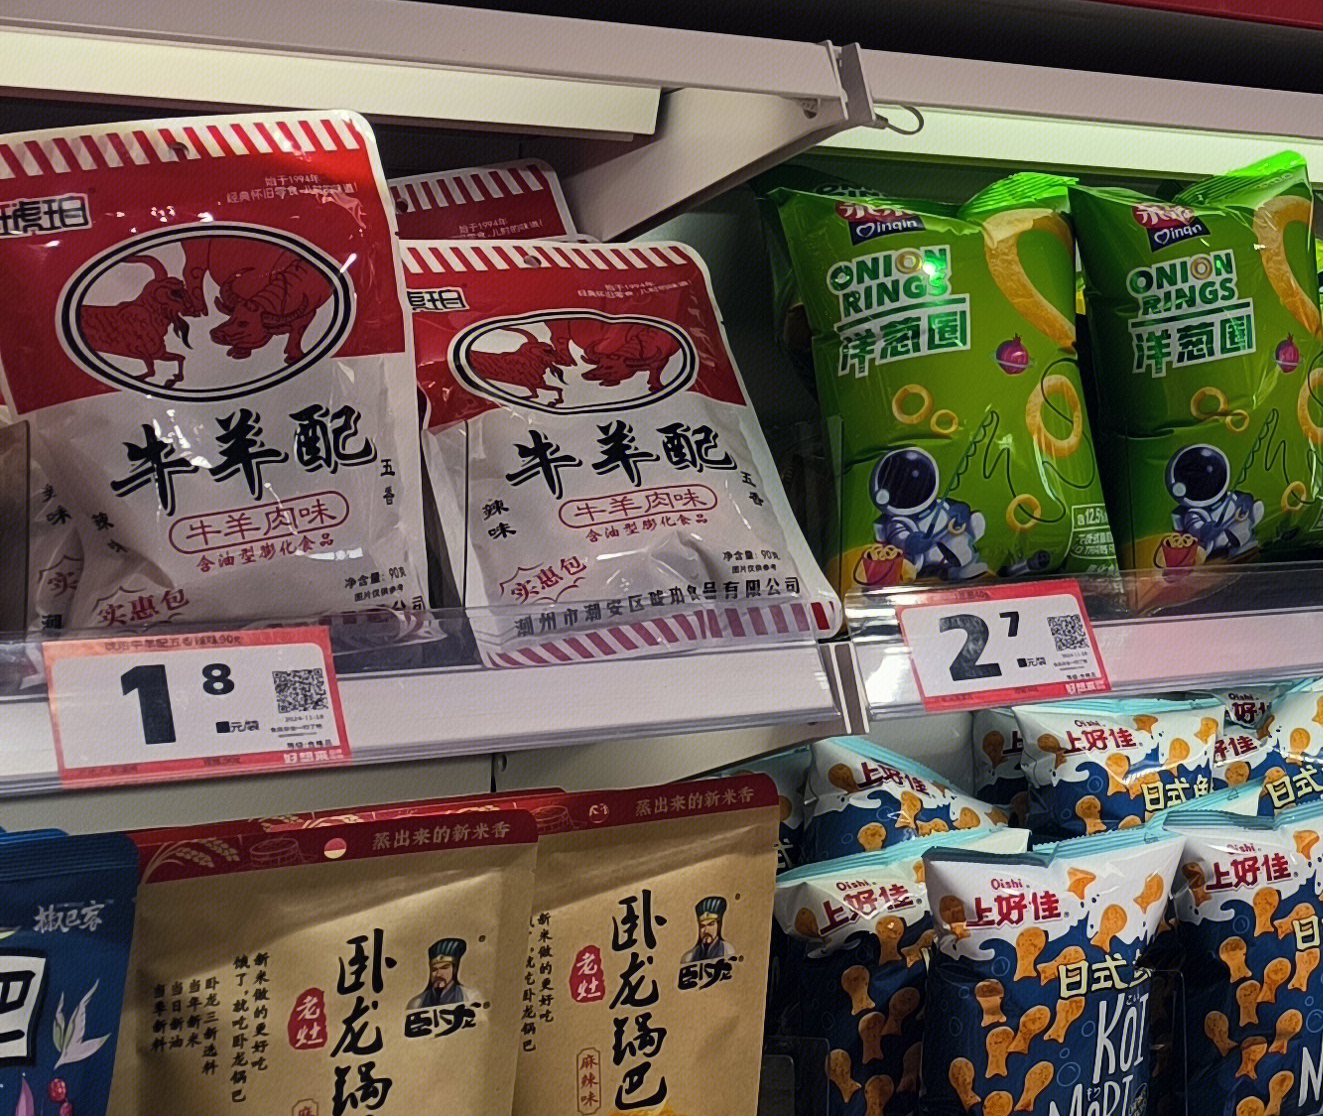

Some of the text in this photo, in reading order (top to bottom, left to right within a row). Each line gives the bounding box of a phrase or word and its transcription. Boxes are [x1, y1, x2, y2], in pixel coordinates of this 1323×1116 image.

[828, 247, 949, 291] ONION
[1128, 252, 1234, 291] ONION
[841, 275, 950, 318] RINGS
[1140, 281, 1236, 316] RINGS
[838, 311, 970, 375] 洋葱圈
[1132, 314, 1254, 376] 洋葱圈
[111, 404, 377, 516] 牛羊配
[506, 420, 737, 500] 牛羊配
[186, 499, 337, 545] 牛羊肉味
[482, 498, 517, 540] 辣味
[575, 488, 708, 522] 牛羊肉味
[586, 514, 708, 542] 含油型膨化食品
[197, 532, 334, 572] 含油型膨化食品
[510, 554, 586, 602] 实惠包
[98, 588, 190, 627] 实惠包
[940, 611, 1019, 681] 2 7
[121, 662, 235, 745] 1 8
[1064, 728, 1139, 754] 上好佳
[858, 761, 930, 796] 上好佳
[636, 785, 755, 817] 蒸出来的新米香
[373, 820, 510, 851] 蒸出来的新米香
[1227, 843, 1258, 855] Oishi
[836, 879, 871, 892] Oishi
[990, 878, 1024, 890] Oishi
[1205, 853, 1292, 891] 上好佳
[819, 882, 914, 935] 上好佳
[966, 890, 1062, 928] 上好佳
[537, 912, 555, 1024] 新米做的更好吃
[677, 956, 738, 992] 卧龙
[169, 981, 184, 1050] 当日新油
[185, 979, 202, 1048] 当年新米
[251, 952, 270, 1072] 新米做的更好吃
[404, 1002, 482, 1039] 卧龙
[609, 889, 668, 1111] 卧龙锅巴
[202, 976, 220, 1076] 卧龙三新选料
[330, 928, 398, 1116] 卧龙锅
[1093, 993, 1149, 1084] KOI
[578, 1053, 600, 1107] 麻辣味
